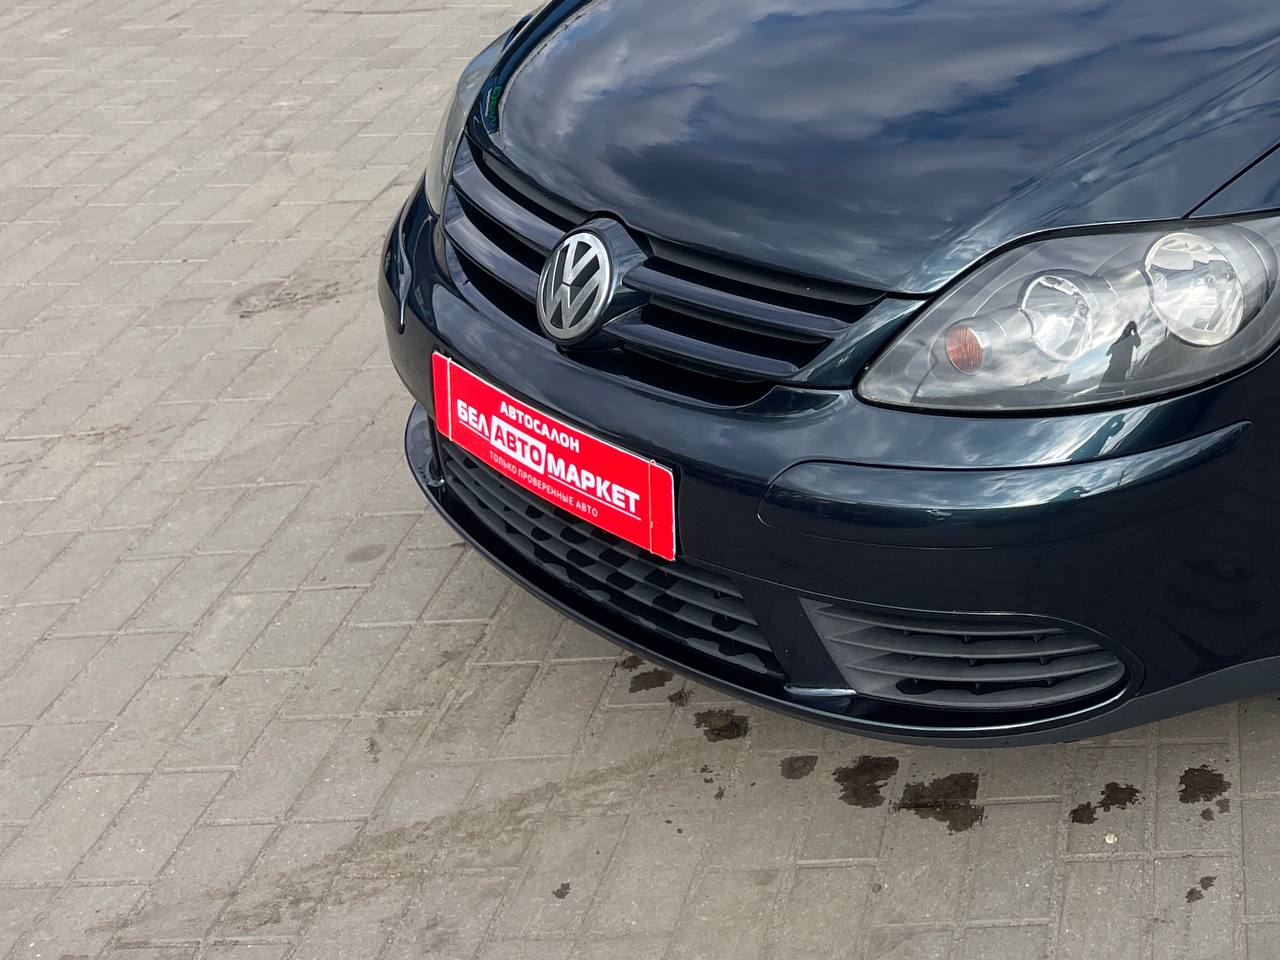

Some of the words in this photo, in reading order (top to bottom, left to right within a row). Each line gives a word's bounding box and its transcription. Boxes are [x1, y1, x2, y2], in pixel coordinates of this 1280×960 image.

[457, 398, 490, 437] БЕЛ
[491, 421, 541, 467] АВТО
[547, 456, 641, 514] МАРКЕТ
[500, 400, 580, 454] АВТОСАЛОН
[489, 450, 517, 476] ТОЛЬКО
[518, 464, 574, 506] ПРОВЕРЕННЫЕ
[576, 499, 599, 518] АВТО
